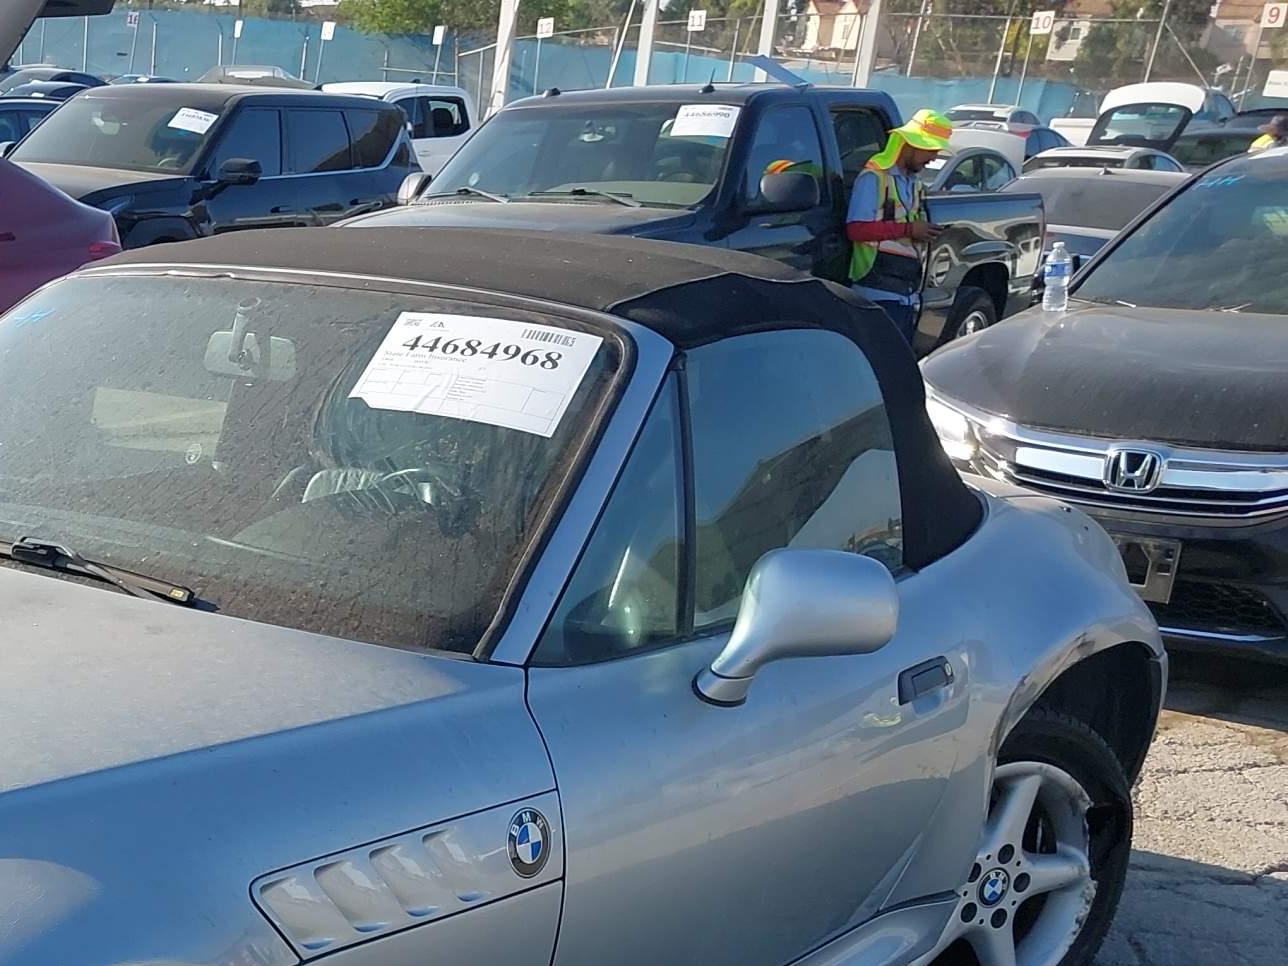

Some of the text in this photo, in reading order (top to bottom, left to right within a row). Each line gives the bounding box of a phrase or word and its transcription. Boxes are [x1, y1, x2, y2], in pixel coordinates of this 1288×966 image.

[691, 15, 703, 27] 11
[1032, 15, 1052, 29] 10
[1267, 6, 1280, 24] 9
[538, 22, 552, 34] 12
[402, 334, 562, 370] 44684968
[428, 353, 468, 363] Insurance
[510, 811, 544, 837] BMW
